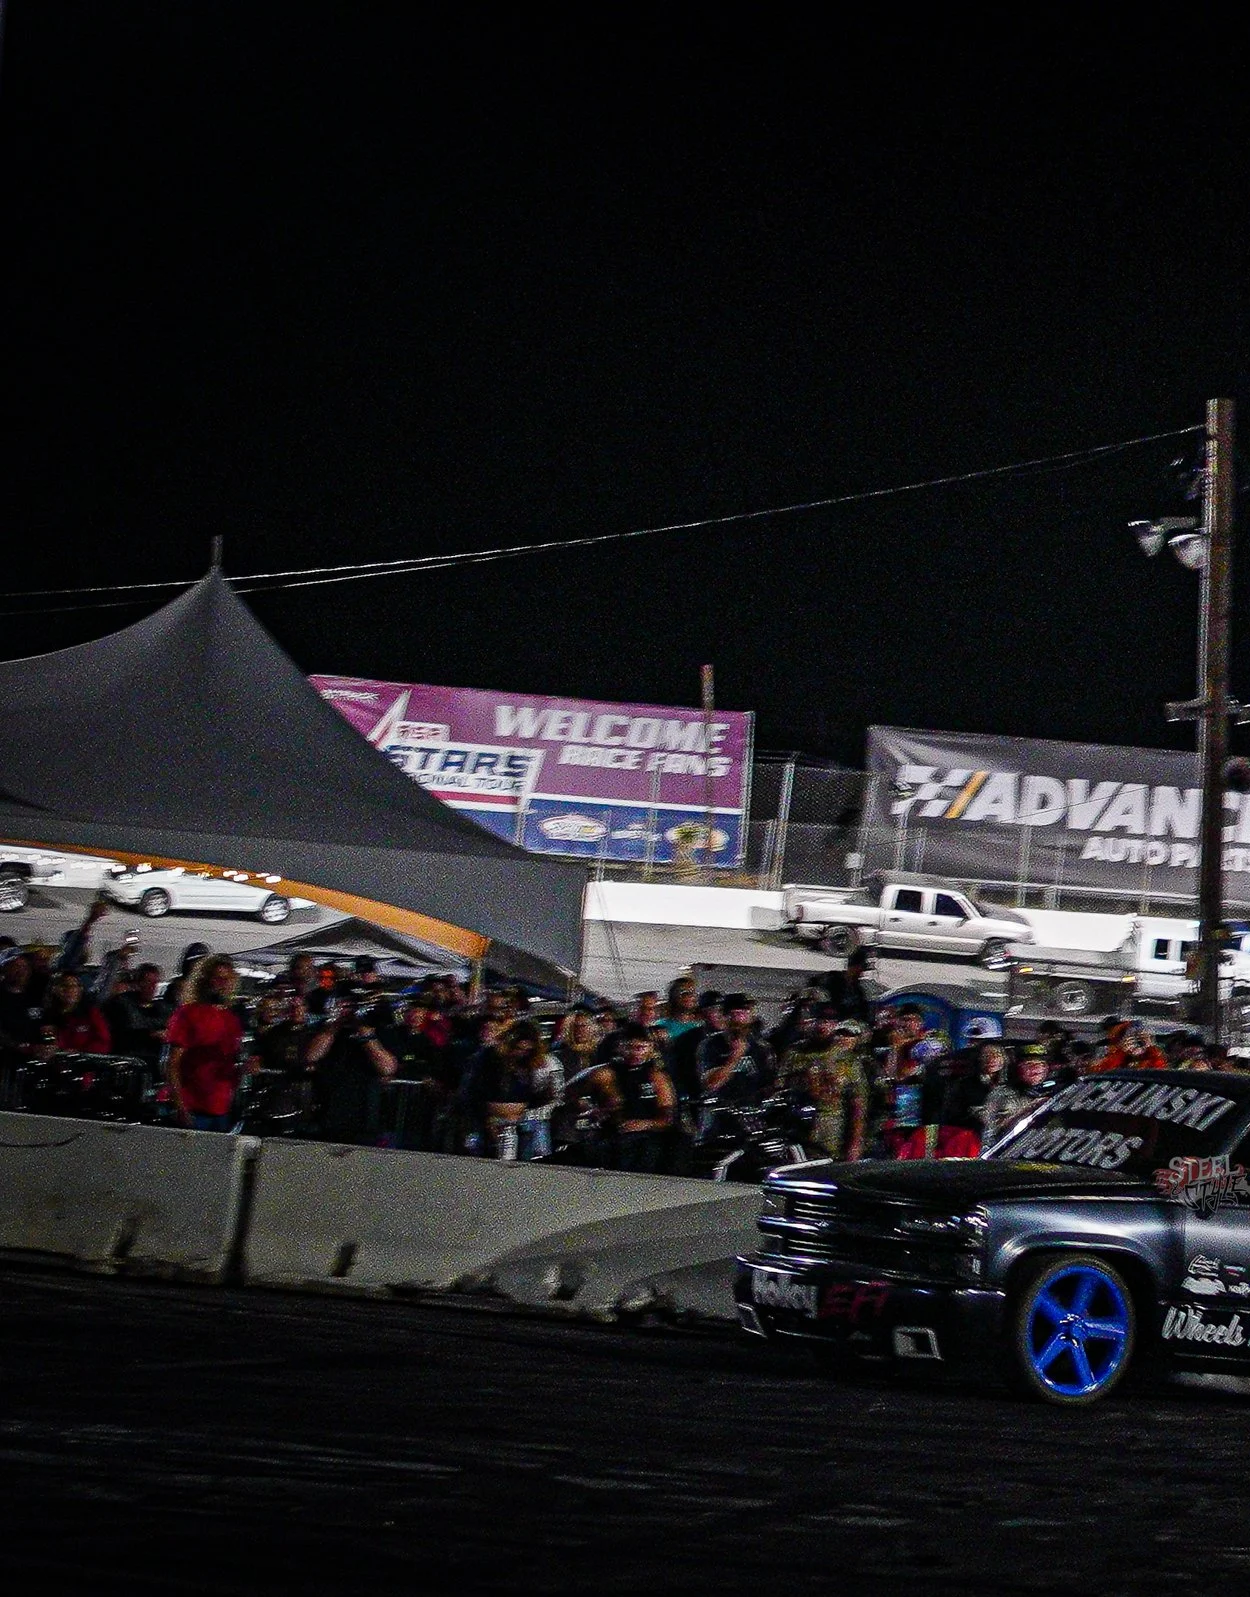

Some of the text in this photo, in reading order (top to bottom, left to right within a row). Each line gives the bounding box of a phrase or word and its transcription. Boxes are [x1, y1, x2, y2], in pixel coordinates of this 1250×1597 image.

[494, 704, 731, 755] WELCOME
[384, 744, 535, 777] STARS
[558, 745, 733, 777] RACE FANS
[1080, 836, 1168, 866] AUTO
[1000, 1126, 1144, 1170] MOTORS
[1168, 1153, 1240, 1184] STEEL
[1161, 1303, 1246, 1345] Wheels
